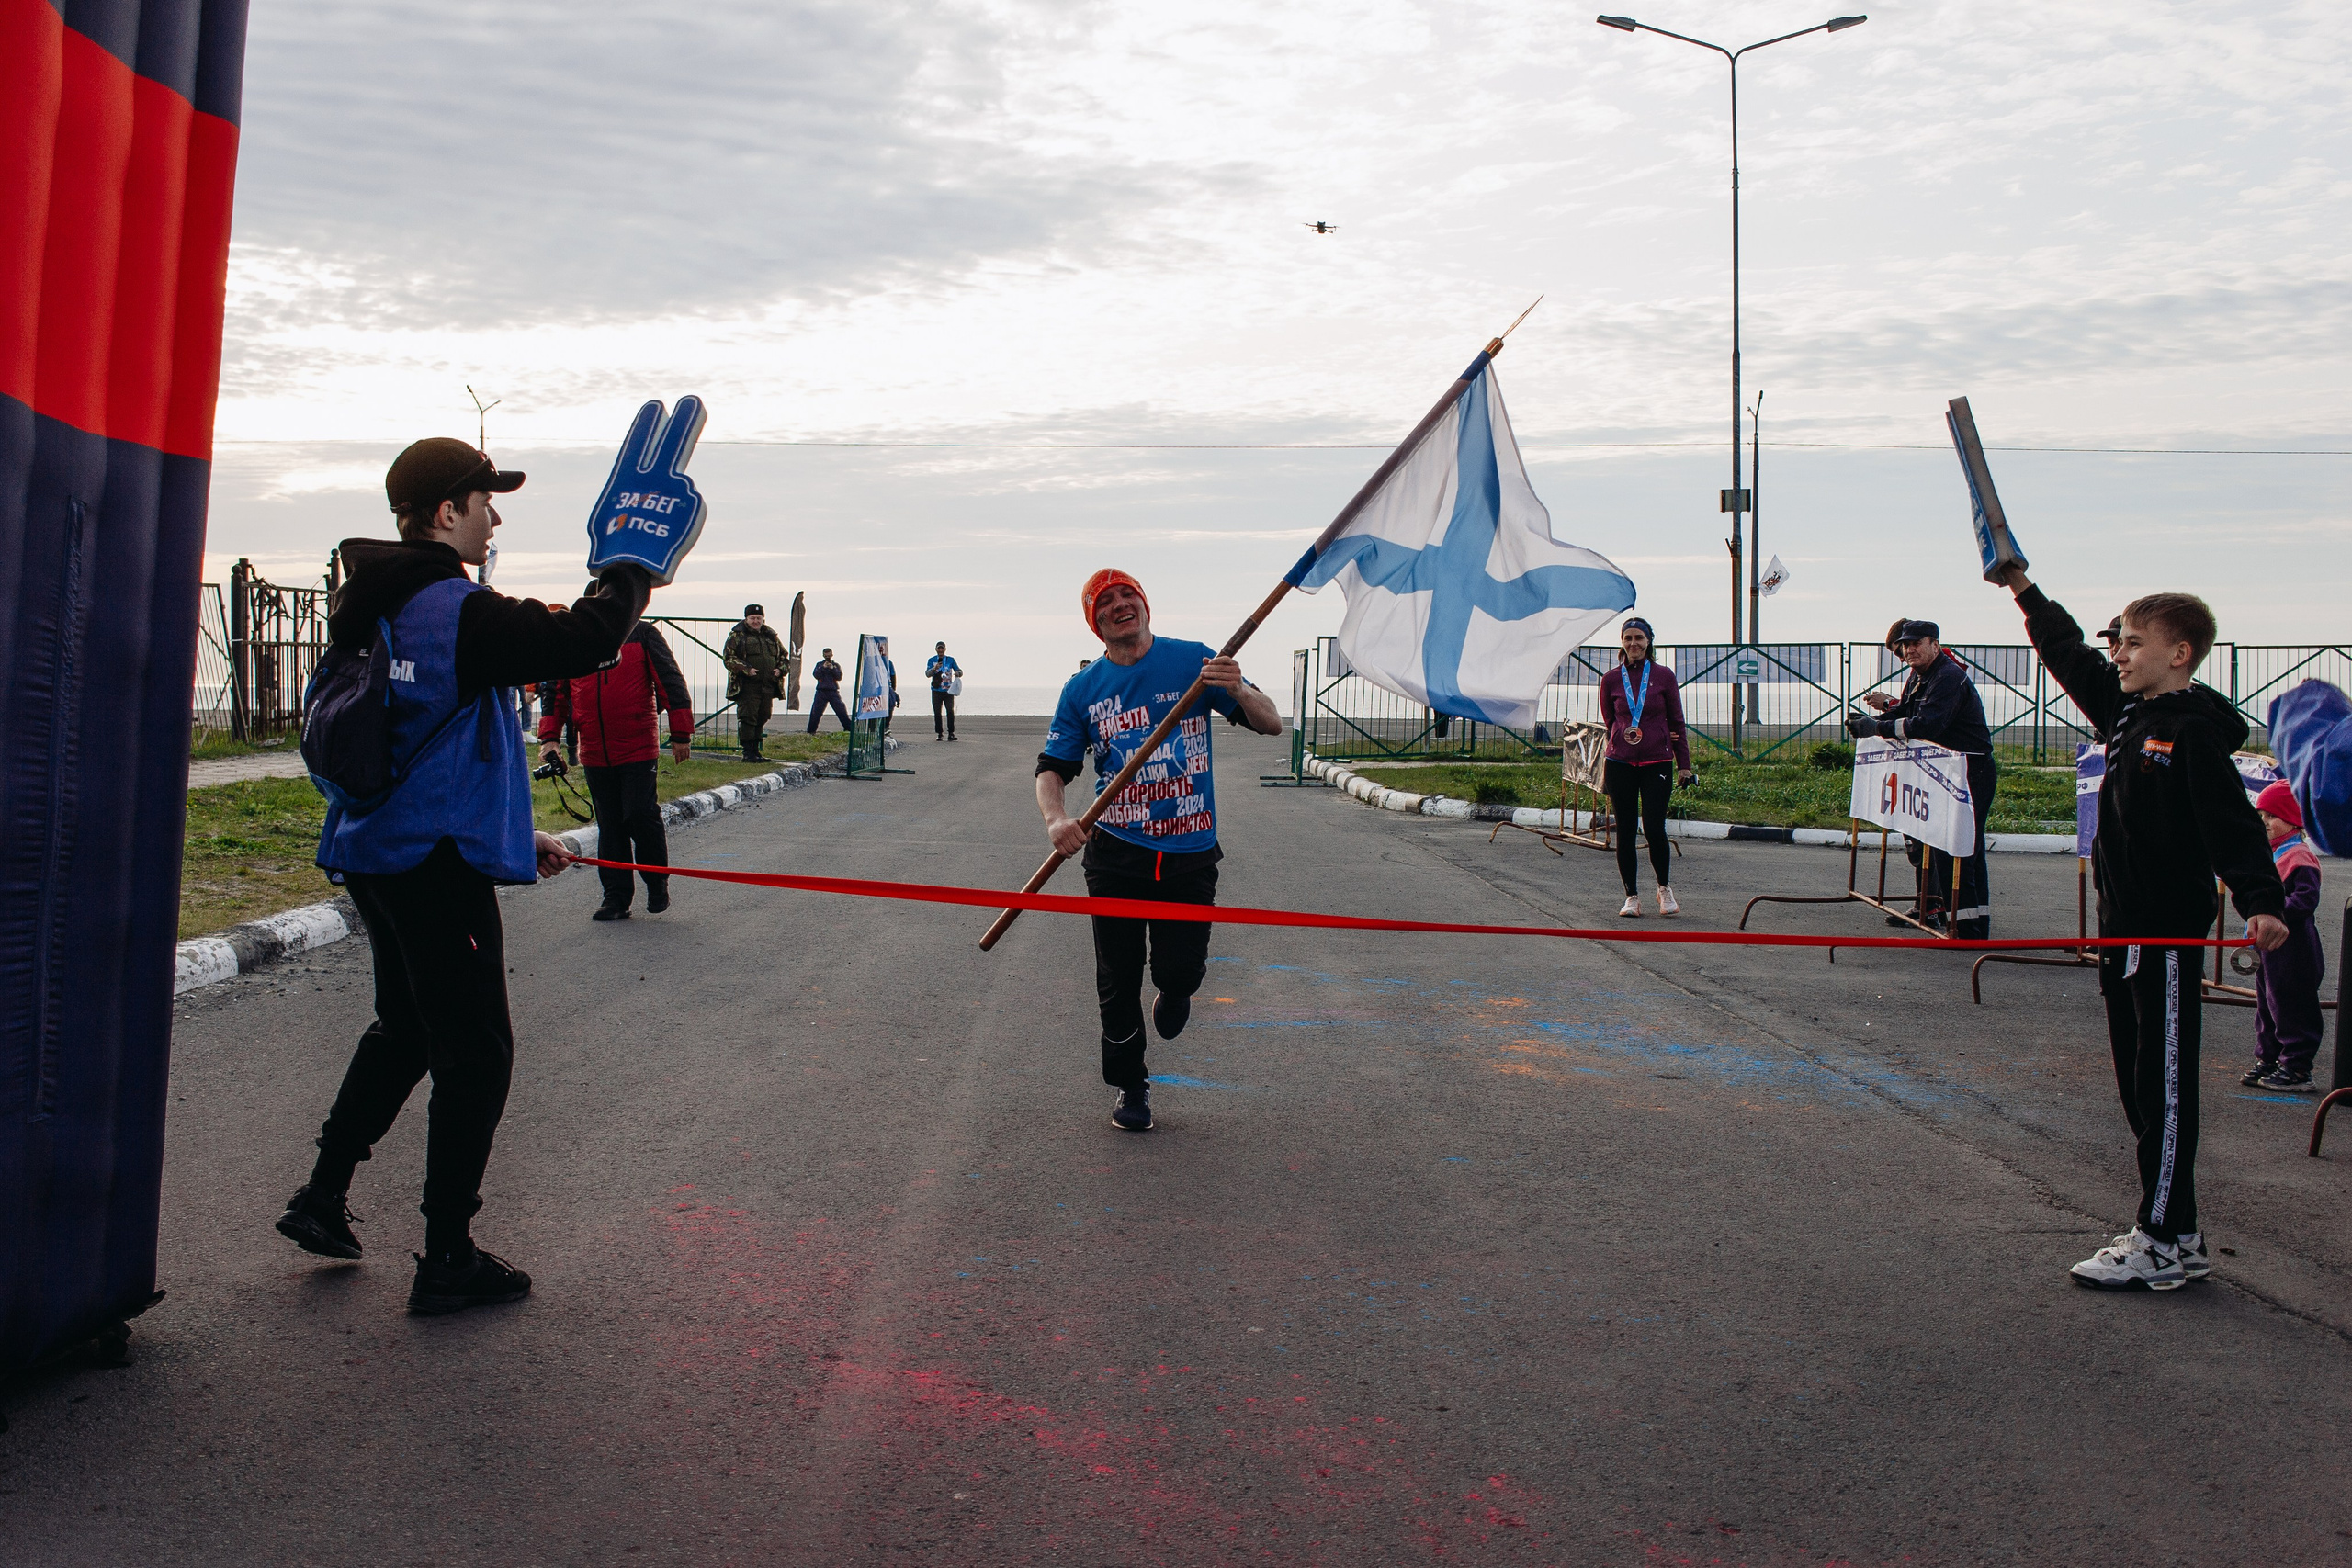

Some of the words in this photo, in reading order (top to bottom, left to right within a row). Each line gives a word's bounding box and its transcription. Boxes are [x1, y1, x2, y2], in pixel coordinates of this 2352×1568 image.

[616, 492, 639, 509] ЗА
[642, 493, 681, 514] БЕГ
[628, 517, 671, 538] ПСБ
[389, 659, 415, 682] ЫХ
[1088, 694, 1123, 724] 2024
[1166, 692, 1180, 702] БЕГ
[1098, 706, 1151, 739] #МЕЧТА
[1046, 730, 1060, 740] СБ
[1183, 733, 1208, 757] 2024
[1183, 752, 1209, 777] МЕНТ
[1177, 793, 1205, 817] 2024
[1902, 783, 1929, 822] ПСБ
[1143, 810, 1212, 837] #ЕДИНСТВО
[2164, 1153, 2174, 1182] YOURSELF
